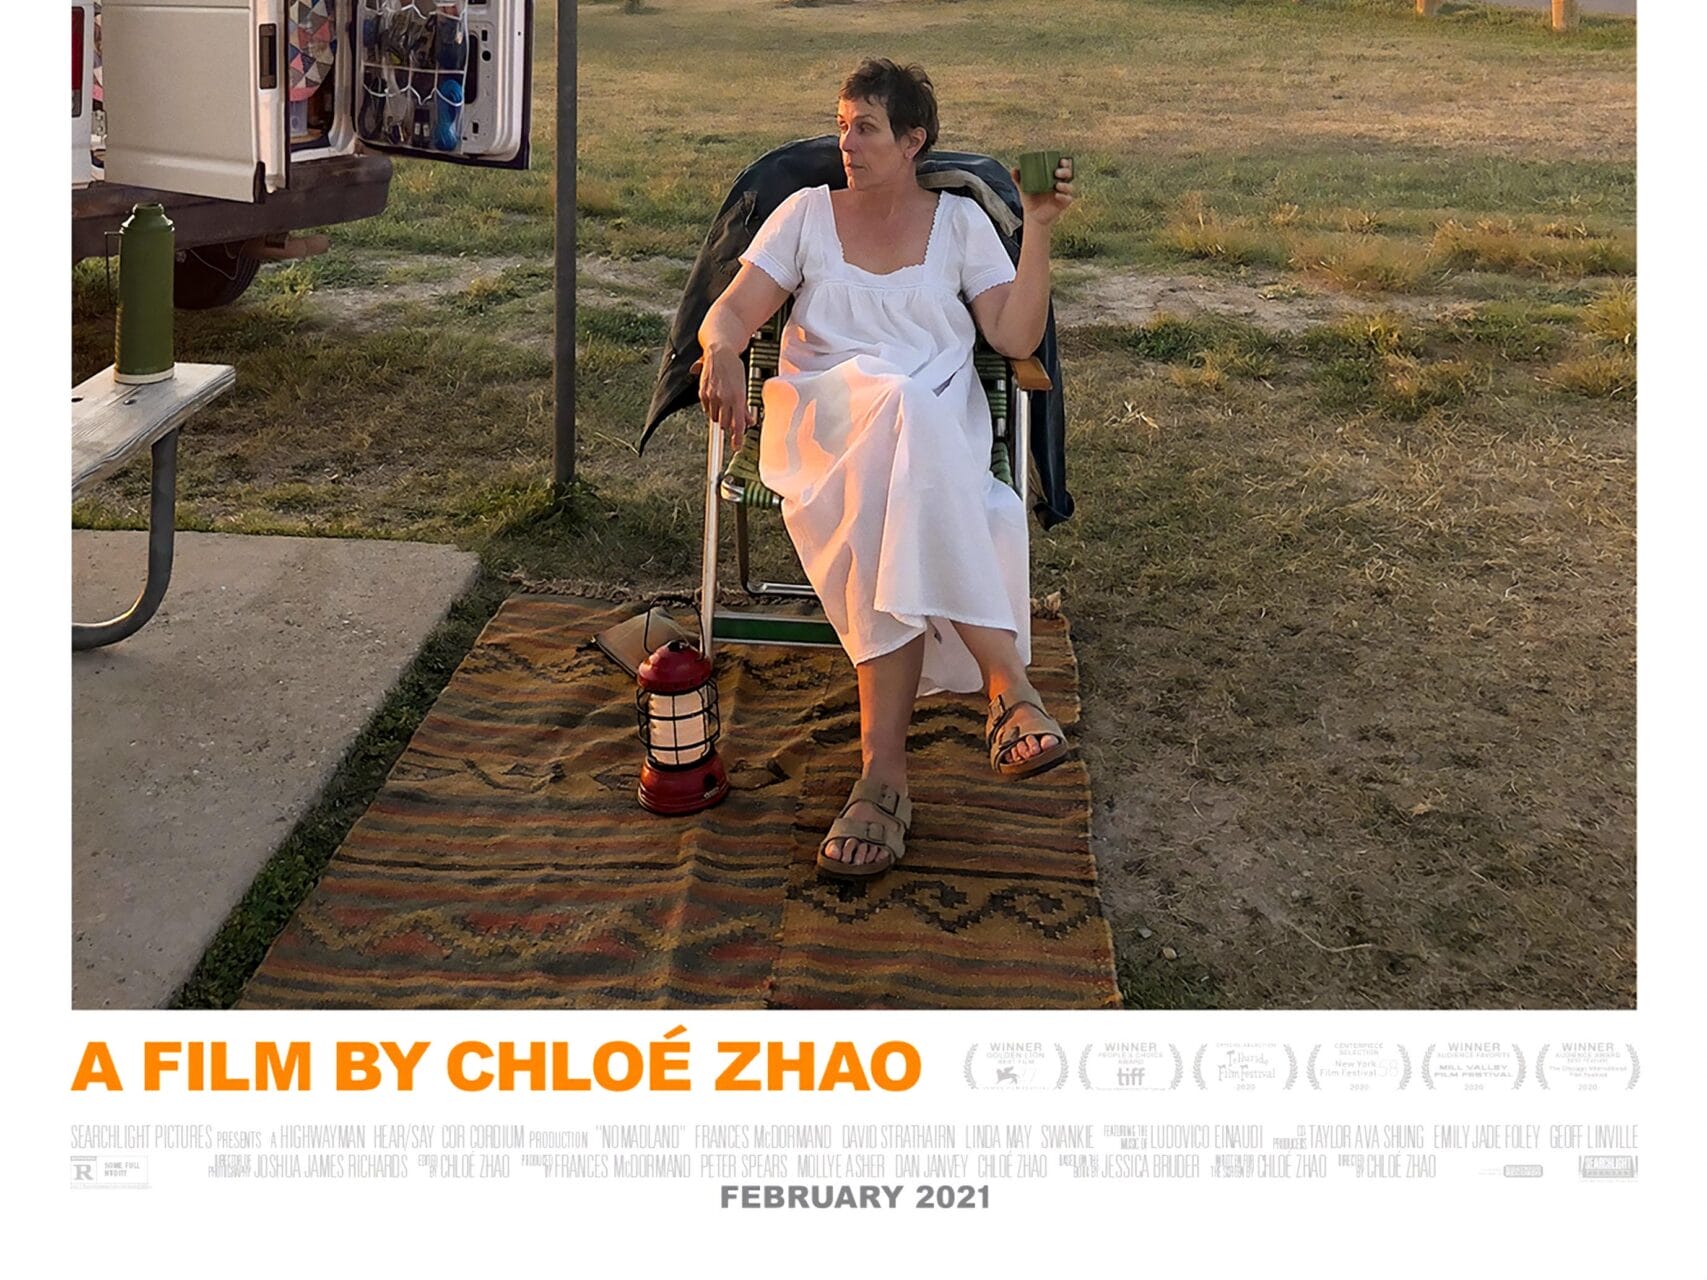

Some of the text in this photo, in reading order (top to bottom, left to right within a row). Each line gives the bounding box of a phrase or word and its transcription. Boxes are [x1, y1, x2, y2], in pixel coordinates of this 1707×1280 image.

[71, 1025, 921, 1092] A FILM BY CHLOÉ ZHAO
[990, 1042, 1042, 1052] WINNER
[1104, 1042, 1157, 1052] WINNER
[1448, 1042, 1501, 1052] WINNER
[1562, 1042, 1614, 1052] WINNER
[1117, 1067, 1145, 1086] tiff
[70, 1125, 150, 1148] SEARCHLIGHT
[155, 1125, 213, 1148] PICTURES
[270, 1131, 276, 1148] A
[281, 1125, 365, 1148] HIGHWAYMAN
[374, 1125, 435, 1151] HEAR/SAY
[442, 1125, 464, 1148] COR
[470, 1125, 524, 1148] CORDIUM
[529, 1131, 588, 1148] PRODUCTION
[695, 1125, 749, 1148] FRANCES
[753, 1125, 832, 1148] McDORMAND
[842, 1125, 877, 1148] DAVID
[881, 1125, 955, 1148] STRATHAIRN
[965, 1125, 1000, 1148] LINDA
[1006, 1125, 1032, 1148] MAY
[1041, 1125, 1094, 1148] SWANKIE
[1151, 1125, 1263, 1148] LUDOVICO EINAUDI
[1308, 1125, 1638, 1148] TAYLOR AVA SHUNG EMILY JADE FOLEY GEOFF LINVILLE
[73, 1164, 94, 1180] R
[254, 1154, 408, 1178] JOSHUA JAMES RICHARDS
[480, 1154, 510, 1178] ZHAO
[555, 1154, 608, 1178] FRANCES
[614, 1154, 690, 1178] McDORMAND
[701, 1154, 737, 1178] PETER
[742, 1154, 787, 1178] SPEARS
[798, 1154, 842, 1178] MOLLYE
[846, 1154, 885, 1178] ASHER
[895, 1154, 920, 1178] DAN
[924, 1154, 968, 1178] JANVEY
[1017, 1154, 1047, 1178] ZHAO
[1102, 1154, 1149, 1178] JESSICA
[1153, 1154, 1200, 1178] BRUDER
[1296, 1154, 1326, 1178] ZHAO
[1407, 1154, 1436, 1178] ZHAO
[722, 1186, 988, 1208] FEBRUARY 2021
